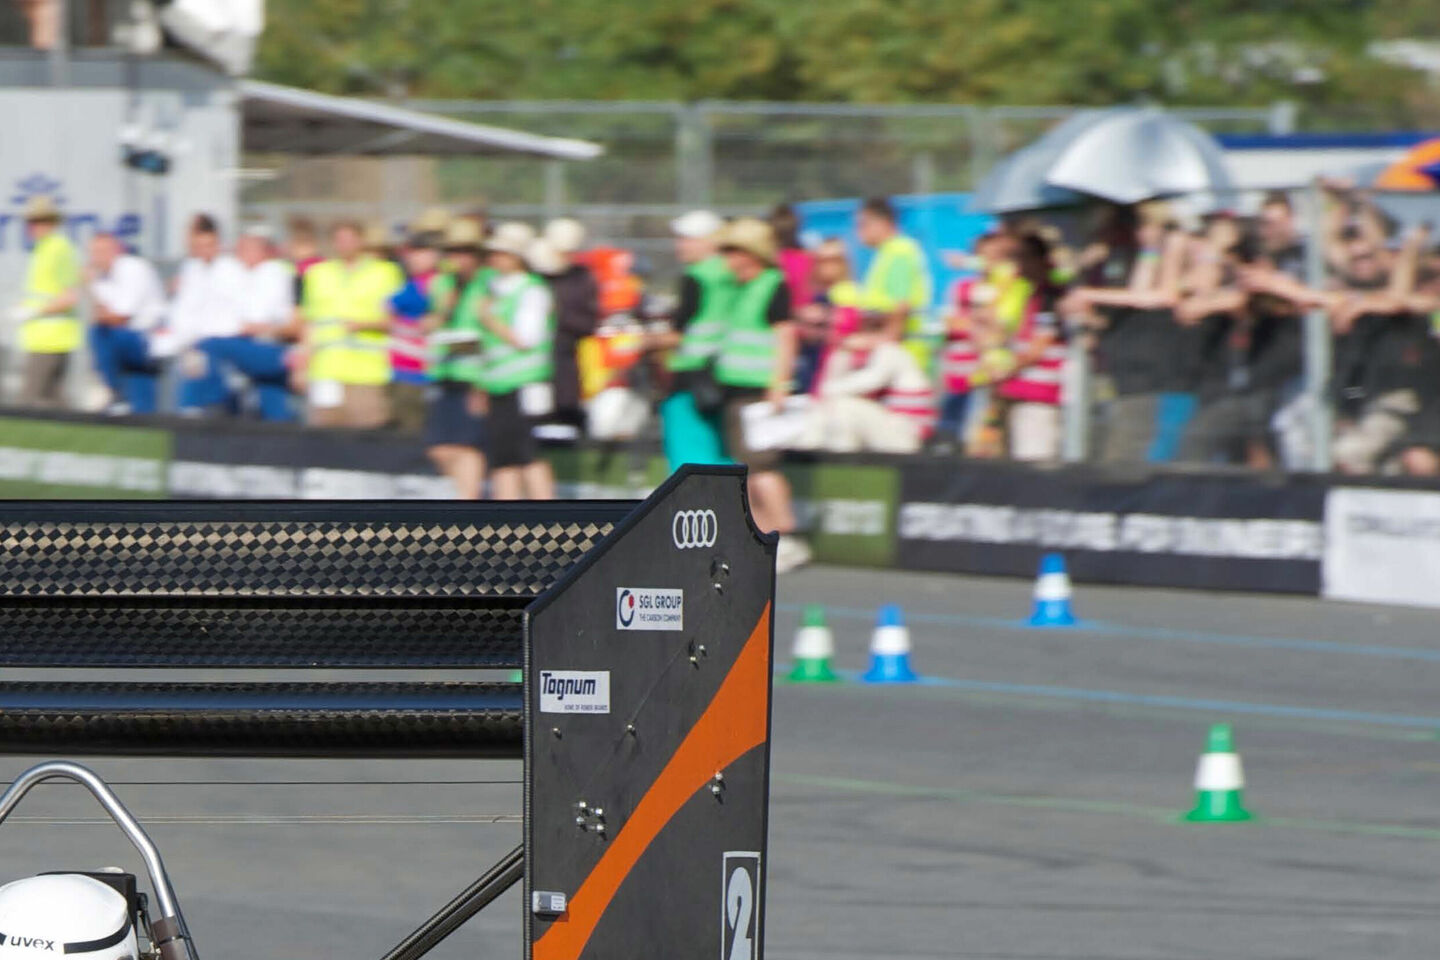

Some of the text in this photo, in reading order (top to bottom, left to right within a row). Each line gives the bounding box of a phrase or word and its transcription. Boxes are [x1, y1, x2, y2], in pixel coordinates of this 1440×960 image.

[639, 595, 681, 608] SGL GROUP
[10, 936, 54, 951] uvex
